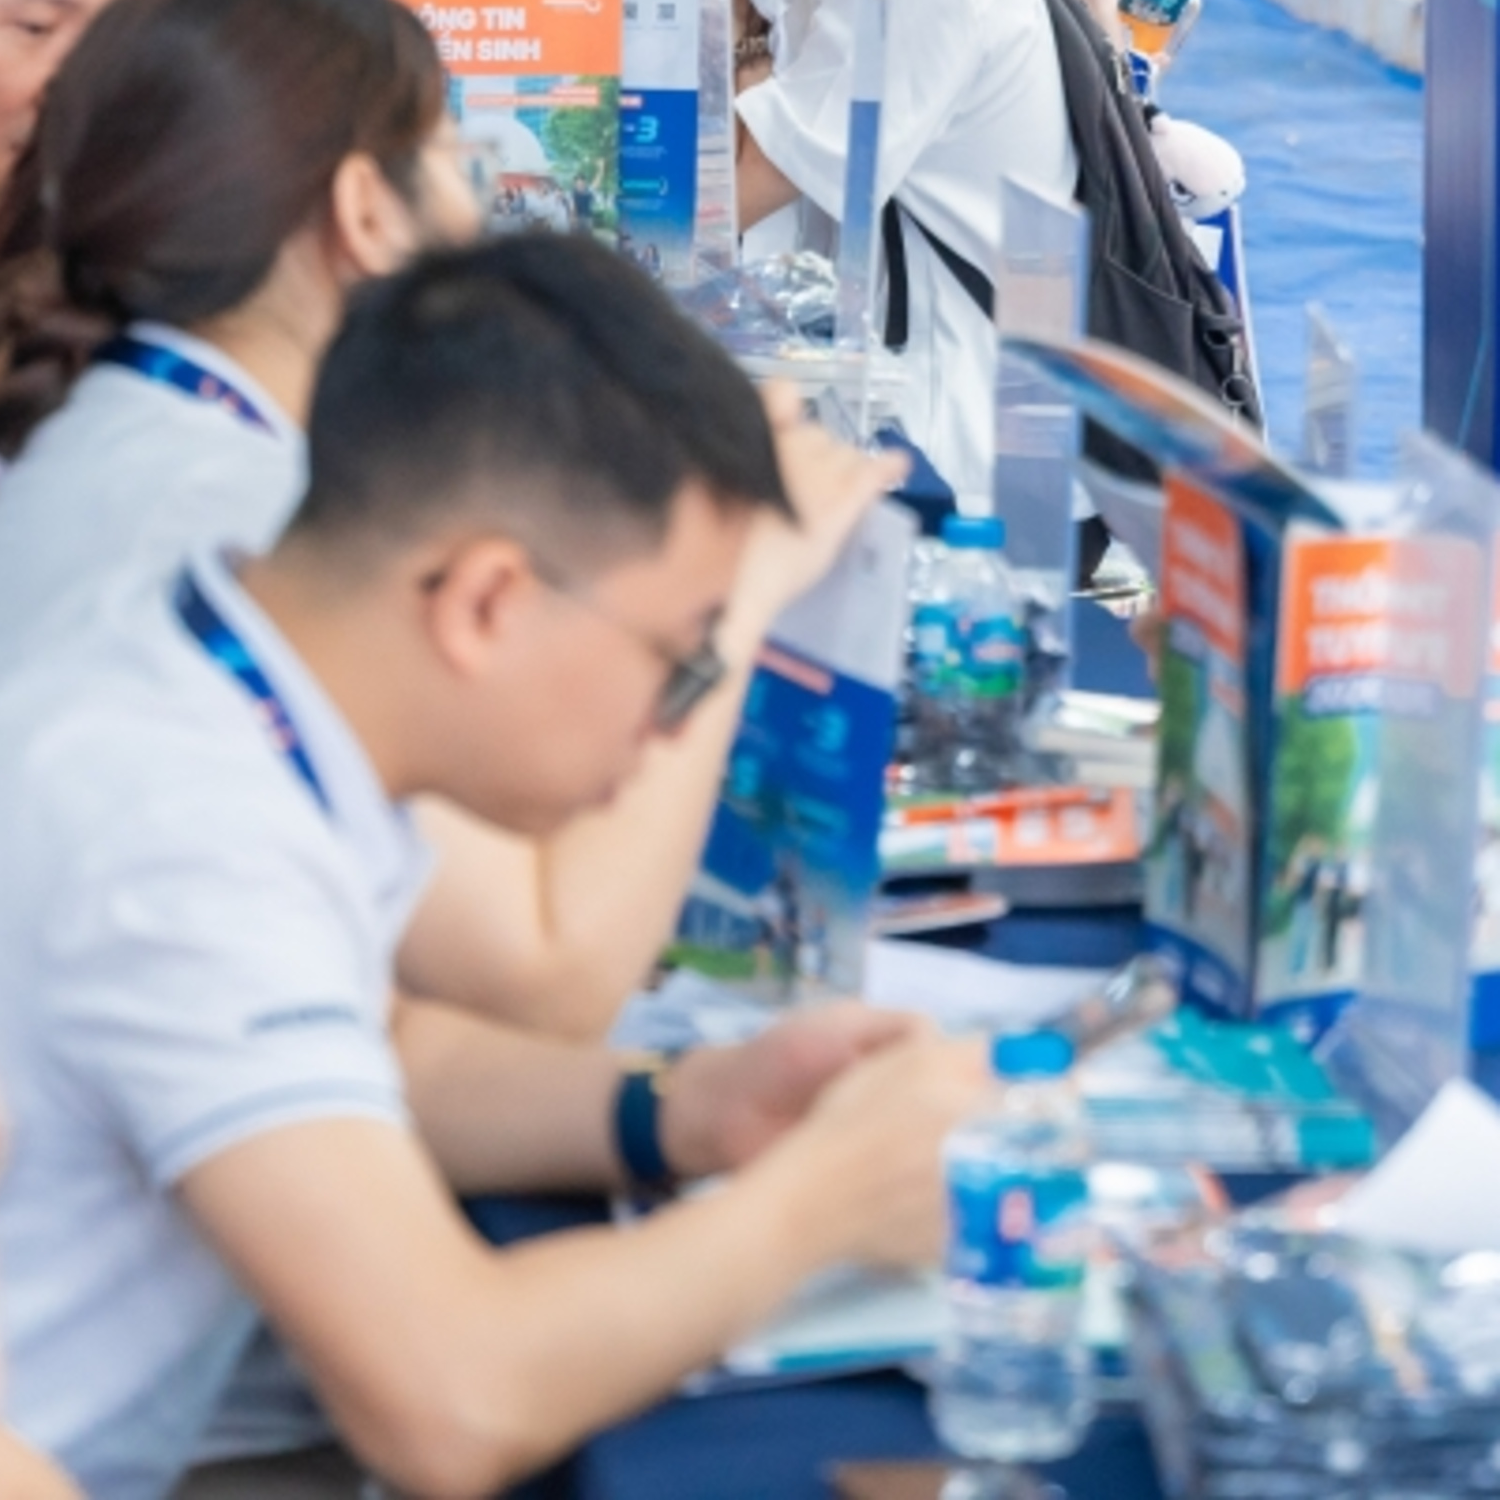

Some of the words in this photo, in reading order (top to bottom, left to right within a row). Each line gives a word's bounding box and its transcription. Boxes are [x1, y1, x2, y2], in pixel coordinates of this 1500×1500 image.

[419, 2, 477, 32] ÔNG
[480, 6, 527, 32] TIN
[476, 37, 542, 62] SINH
